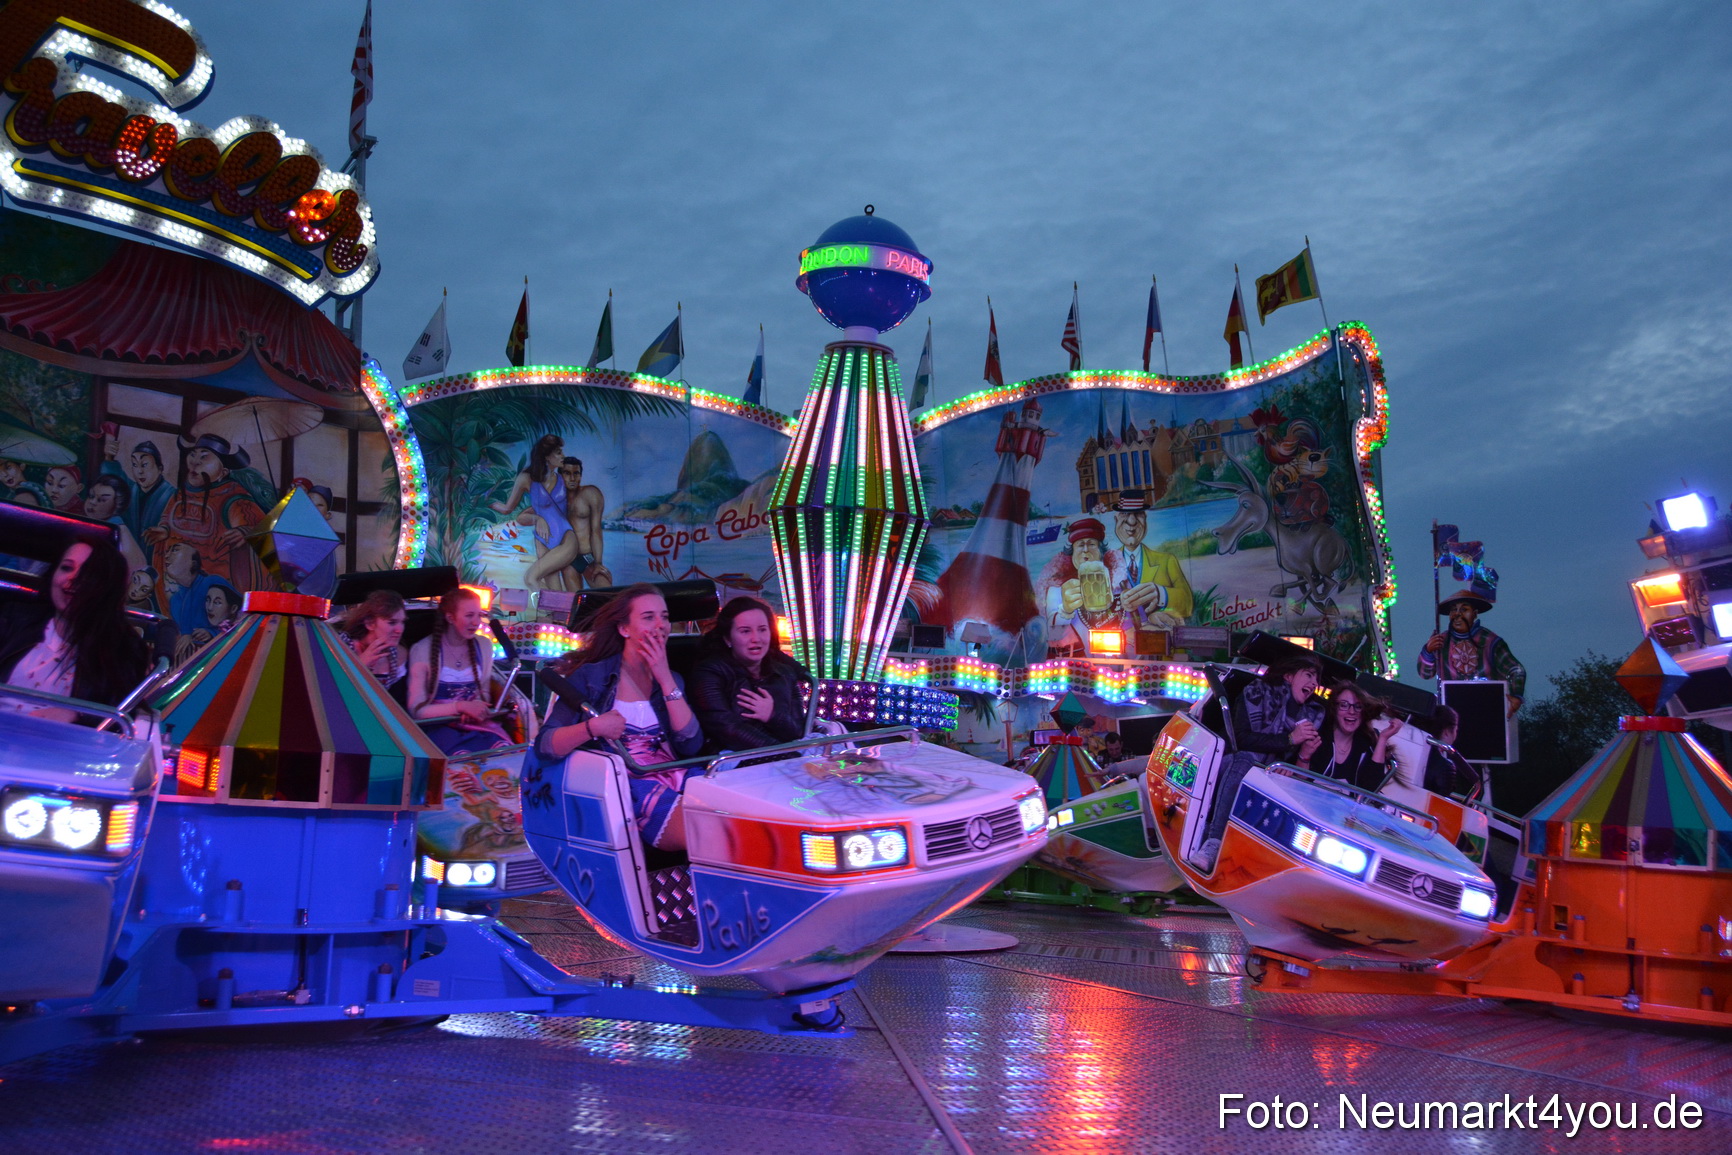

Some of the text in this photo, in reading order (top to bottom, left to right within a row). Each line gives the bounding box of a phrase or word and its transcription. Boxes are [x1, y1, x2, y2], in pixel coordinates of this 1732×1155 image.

[801, 246, 869, 272] LONDON
[886, 251, 929, 281] PARIS
[644, 524, 710, 561] Copa
